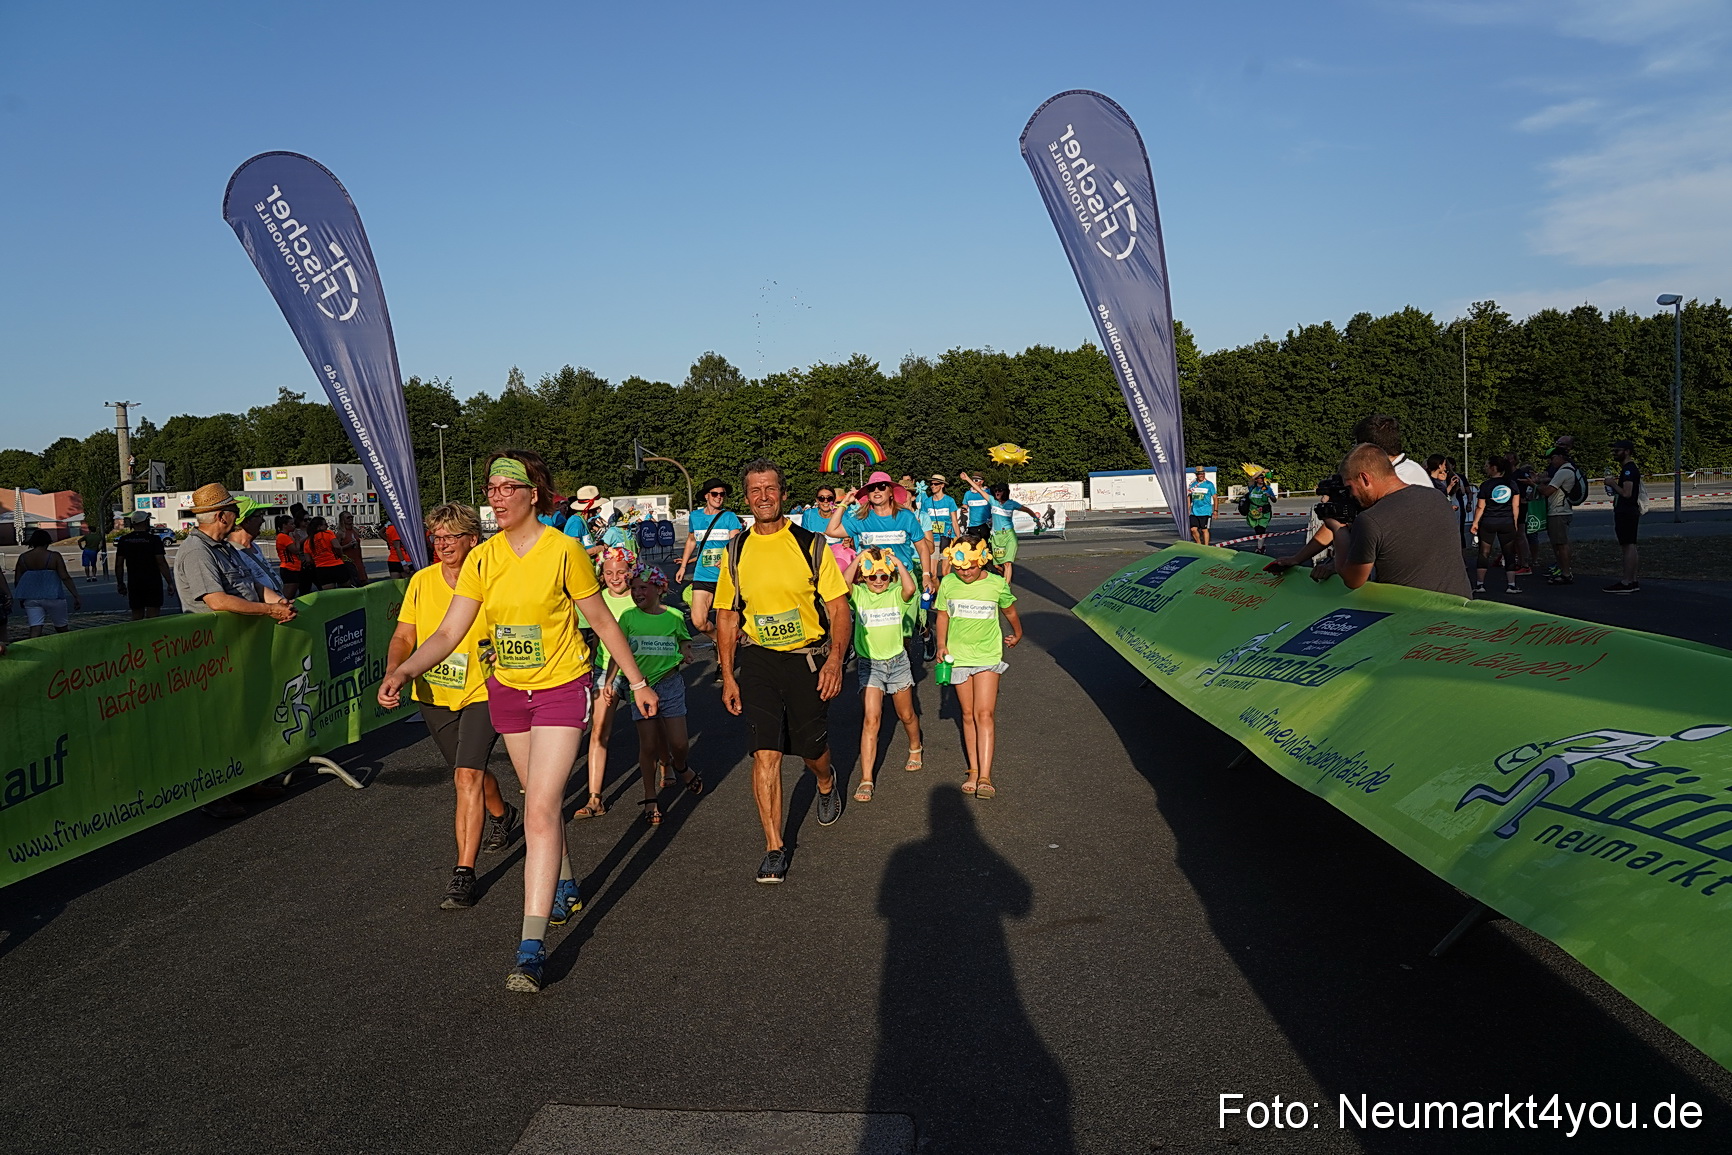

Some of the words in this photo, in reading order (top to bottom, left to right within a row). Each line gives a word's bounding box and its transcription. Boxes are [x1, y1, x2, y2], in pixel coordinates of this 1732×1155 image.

[1201, 563, 1250, 583] Gesunde
[334, 628, 364, 647] Fischer
[764, 622, 795, 637] 1288
[1409, 620, 1519, 643] Gesunde
[1511, 620, 1614, 646] Firmen
[500, 640, 533, 654] 1266
[1400, 642, 1478, 664] laufen
[1468, 652, 1608, 681] länger!
[48, 643, 147, 700] Gesunde
[152, 629, 215, 663] Firmen
[430, 663, 456, 677] 281
[98, 679, 163, 721] laufen
[167, 646, 233, 691] länger!
[1239, 706, 1394, 794] www.firmenlauf-oberpfalz.de
[8, 757, 245, 864] www.firmenlauf-oberpfalz.de
[1533, 824, 1732, 896] neumarkt
